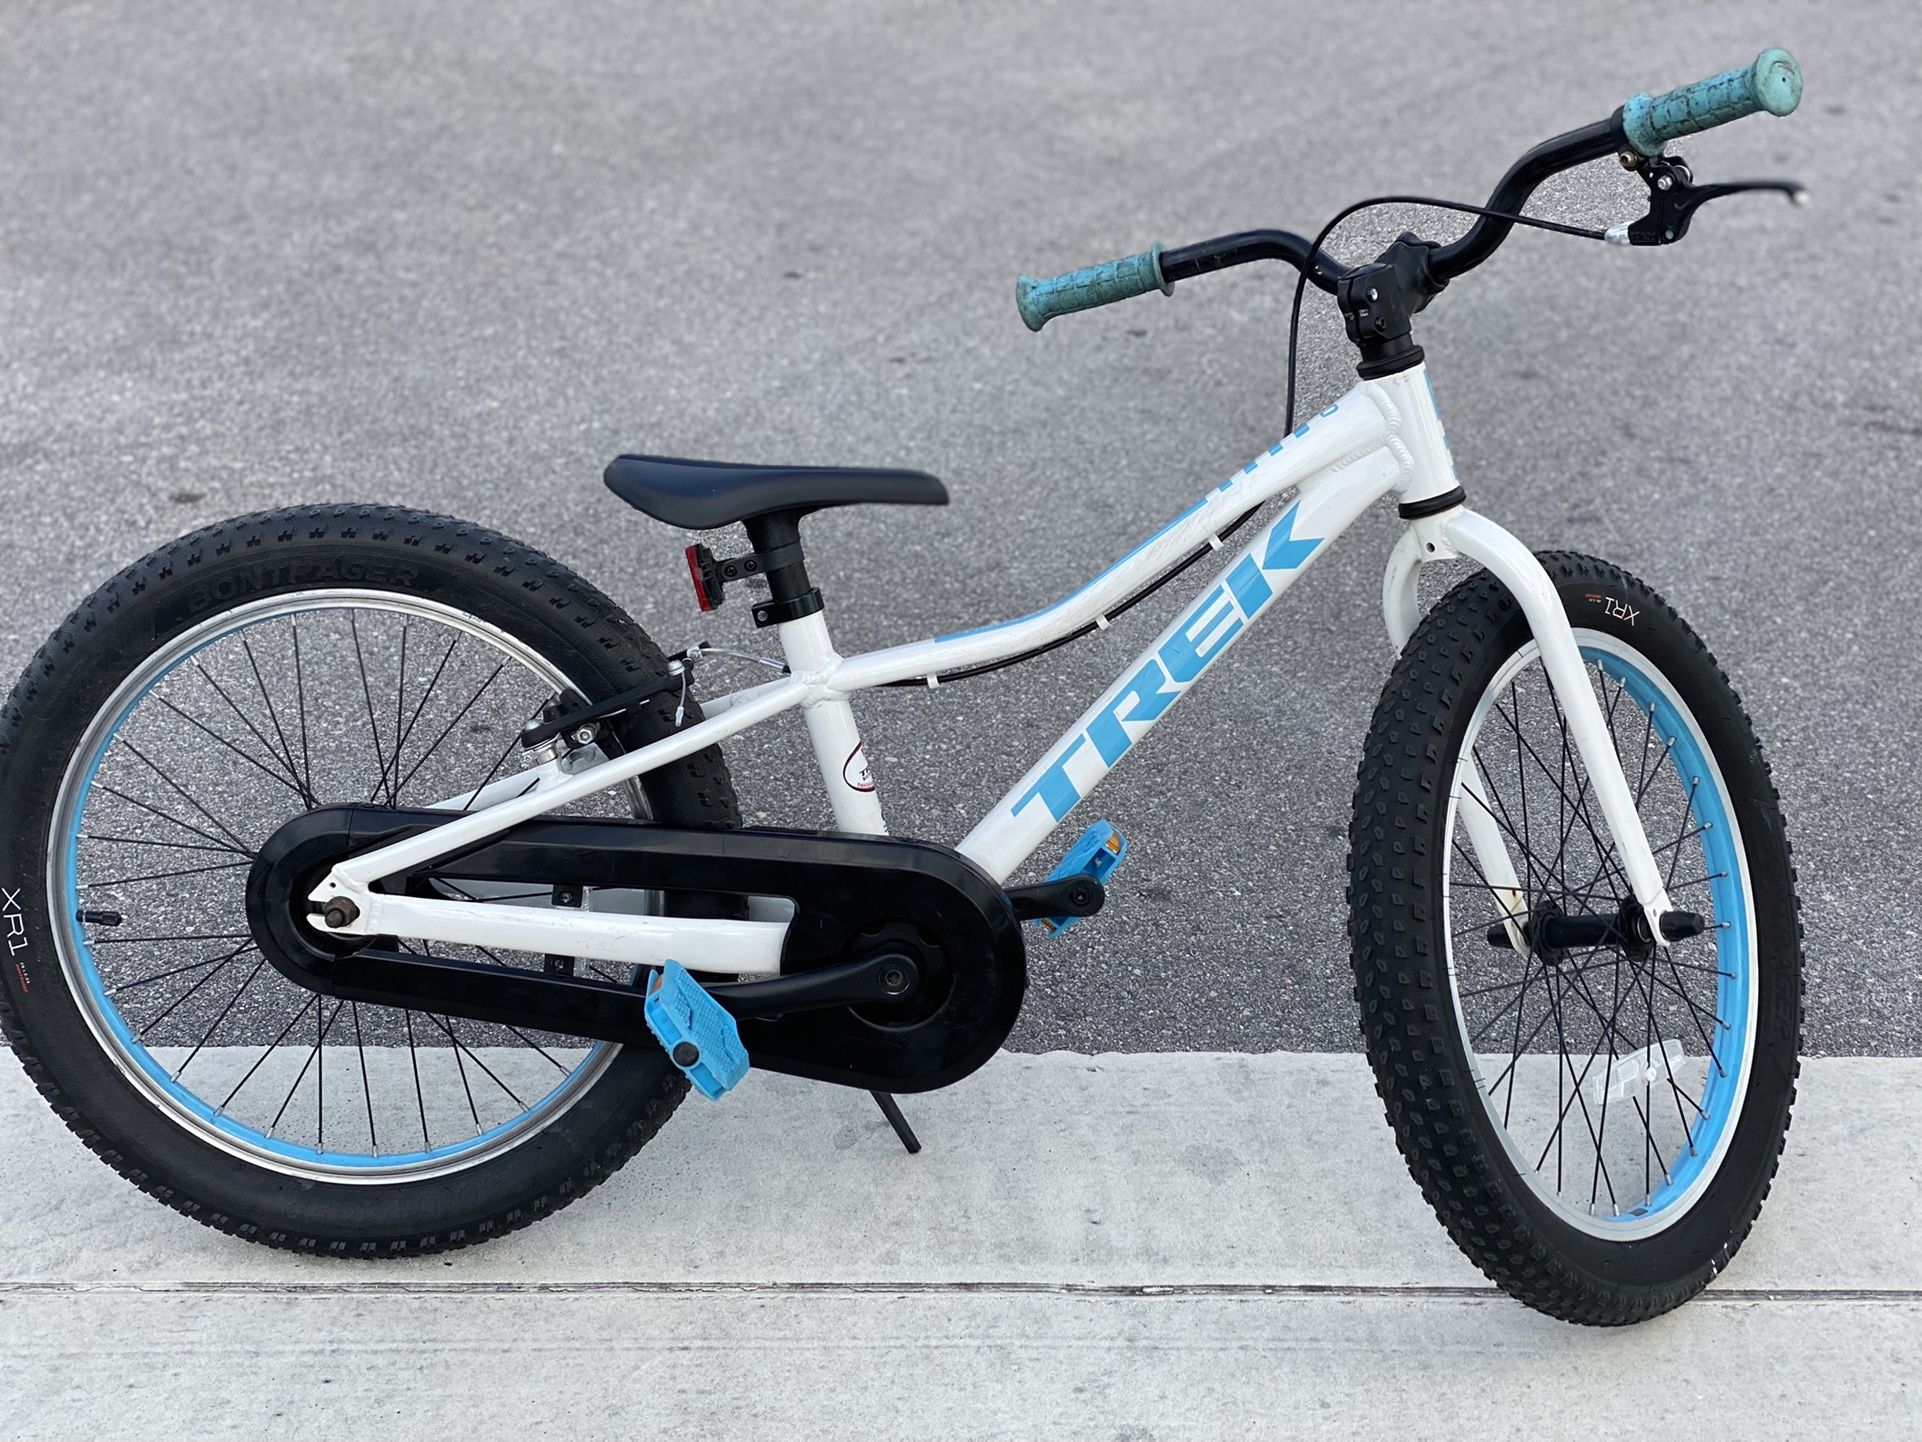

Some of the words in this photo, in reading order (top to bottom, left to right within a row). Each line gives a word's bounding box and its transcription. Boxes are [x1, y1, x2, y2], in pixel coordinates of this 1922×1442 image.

[1604, 596, 1640, 627] XR1
[1010, 499, 1326, 824] TREK
[1, 887, 29, 957] XR1
